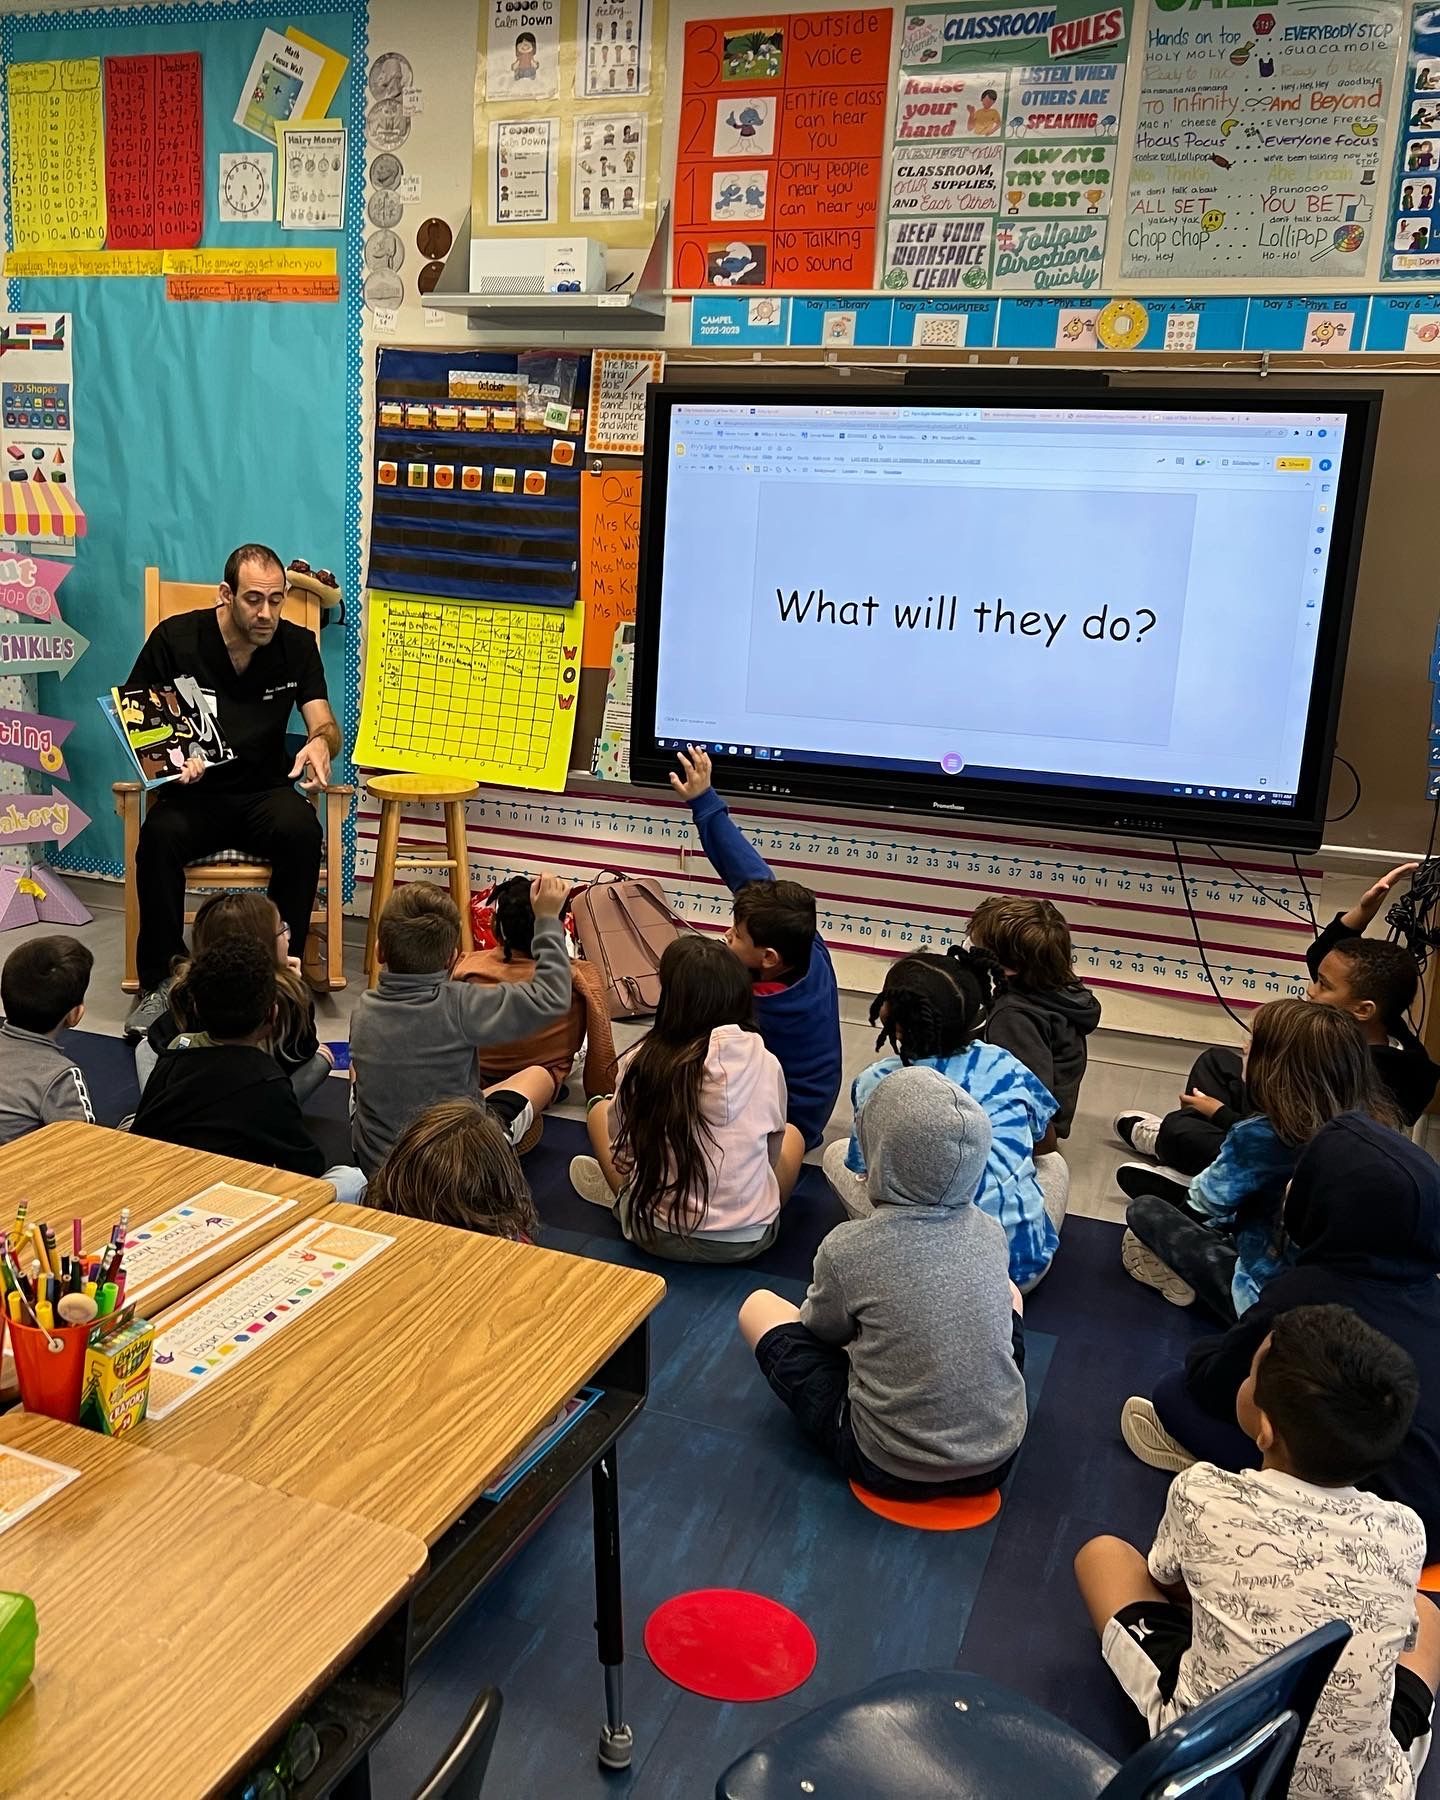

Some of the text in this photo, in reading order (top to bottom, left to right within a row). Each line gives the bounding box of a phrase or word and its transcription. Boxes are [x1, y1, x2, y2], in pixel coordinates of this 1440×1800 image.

[521, 15, 553, 27] Down
[793, 13, 880, 41] Outside
[945, 10, 1122, 54] CLASSROOM RULES
[1148, 26, 1241, 48] Hands on top
[1285, 22, 1393, 41] EVERYBODY STOP
[285, 45, 300, 59] Math
[689, 25, 720, 89] 3
[805, 44, 862, 68] voice
[1146, 49, 1225, 61] HOLY MOLY
[291, 62, 303, 76] Wall
[1020, 65, 1117, 83] LISTEN WHEN
[904, 80, 965, 95] Raise
[785, 89, 883, 111] Entire class
[1022, 89, 1110, 106] OTHERS ARE
[1174, 92, 1239, 118] Infinity
[1269, 84, 1382, 112] And Beyond
[795, 110, 868, 129] can hear
[903, 102, 958, 120] your
[684, 98, 707, 154] 2
[899, 120, 956, 138] hand
[1027, 113, 1098, 129] SPEAKING
[1137, 132, 1227, 148] Hocus Pocus
[1265, 134, 1332, 148] Everyone
[898, 146, 969, 160] RESPECT
[1014, 147, 1106, 164] ALWAYS
[779, 161, 869, 181] Only people
[897, 164, 994, 177] CLASSROOM,
[1006, 170, 1046, 186] TRY
[1052, 169, 1110, 185] YOUR
[788, 181, 853, 197] near you
[932, 180, 996, 190] SUPPLIES,
[676, 167, 708, 226] 1
[892, 193, 997, 211] AND Each Other
[1028, 191, 1081, 207] BEST
[1260, 193, 1356, 214] YOU BET
[780, 200, 877, 218] can hear you
[1131, 198, 1212, 214] ALL SET
[897, 222, 985, 243] KEEP YOUR
[1012, 223, 1097, 253] Follow
[892, 245, 987, 265] WORKSPACE
[996, 245, 1103, 277] Directions
[1034, 265, 1099, 290] Quickly
[807, 301, 822, 310] Day
[839, 300, 870, 310] Library
[900, 302, 917, 312] Day
[935, 303, 990, 312] COMPUTERS
[1148, 302, 1206, 311] Day 4 ART
[1263, 300, 1283, 310] Day
[1287, 300, 1293, 309] 5
[1334, 301, 1347, 310] Ed
[700, 316, 733, 324] CAMPEL
[700, 326, 740, 335] 2022-2023
[13, 384, 58, 395] 2D Shapes
[478, 380, 505, 392] October
[602, 477, 633, 502] Our
[594, 513, 617, 533] Mrs
[592, 536, 616, 553] Mrs
[590, 560, 613, 575] Miss
[594, 579, 613, 596] Ms
[593, 603, 610, 620] Ms
[776, 588, 1157, 648] What will they do?
[541, 815, 550, 824] 12
[558, 817, 567, 825] 13
[574, 819, 583, 827] 14
[591, 820, 601, 829] 15
[609, 822, 618, 831] 16
[626, 824, 635, 832] 17
[643, 826, 653, 835] 18
[661, 828, 671, 836] 19
[677, 829, 689, 838] 20
[1088, 956, 1305, 996] 91 92 93 94 95 97 98 99 100
[109, 1389, 145, 1422] CRAYONS
[1251, 1624, 1306, 1635] HURLEY
